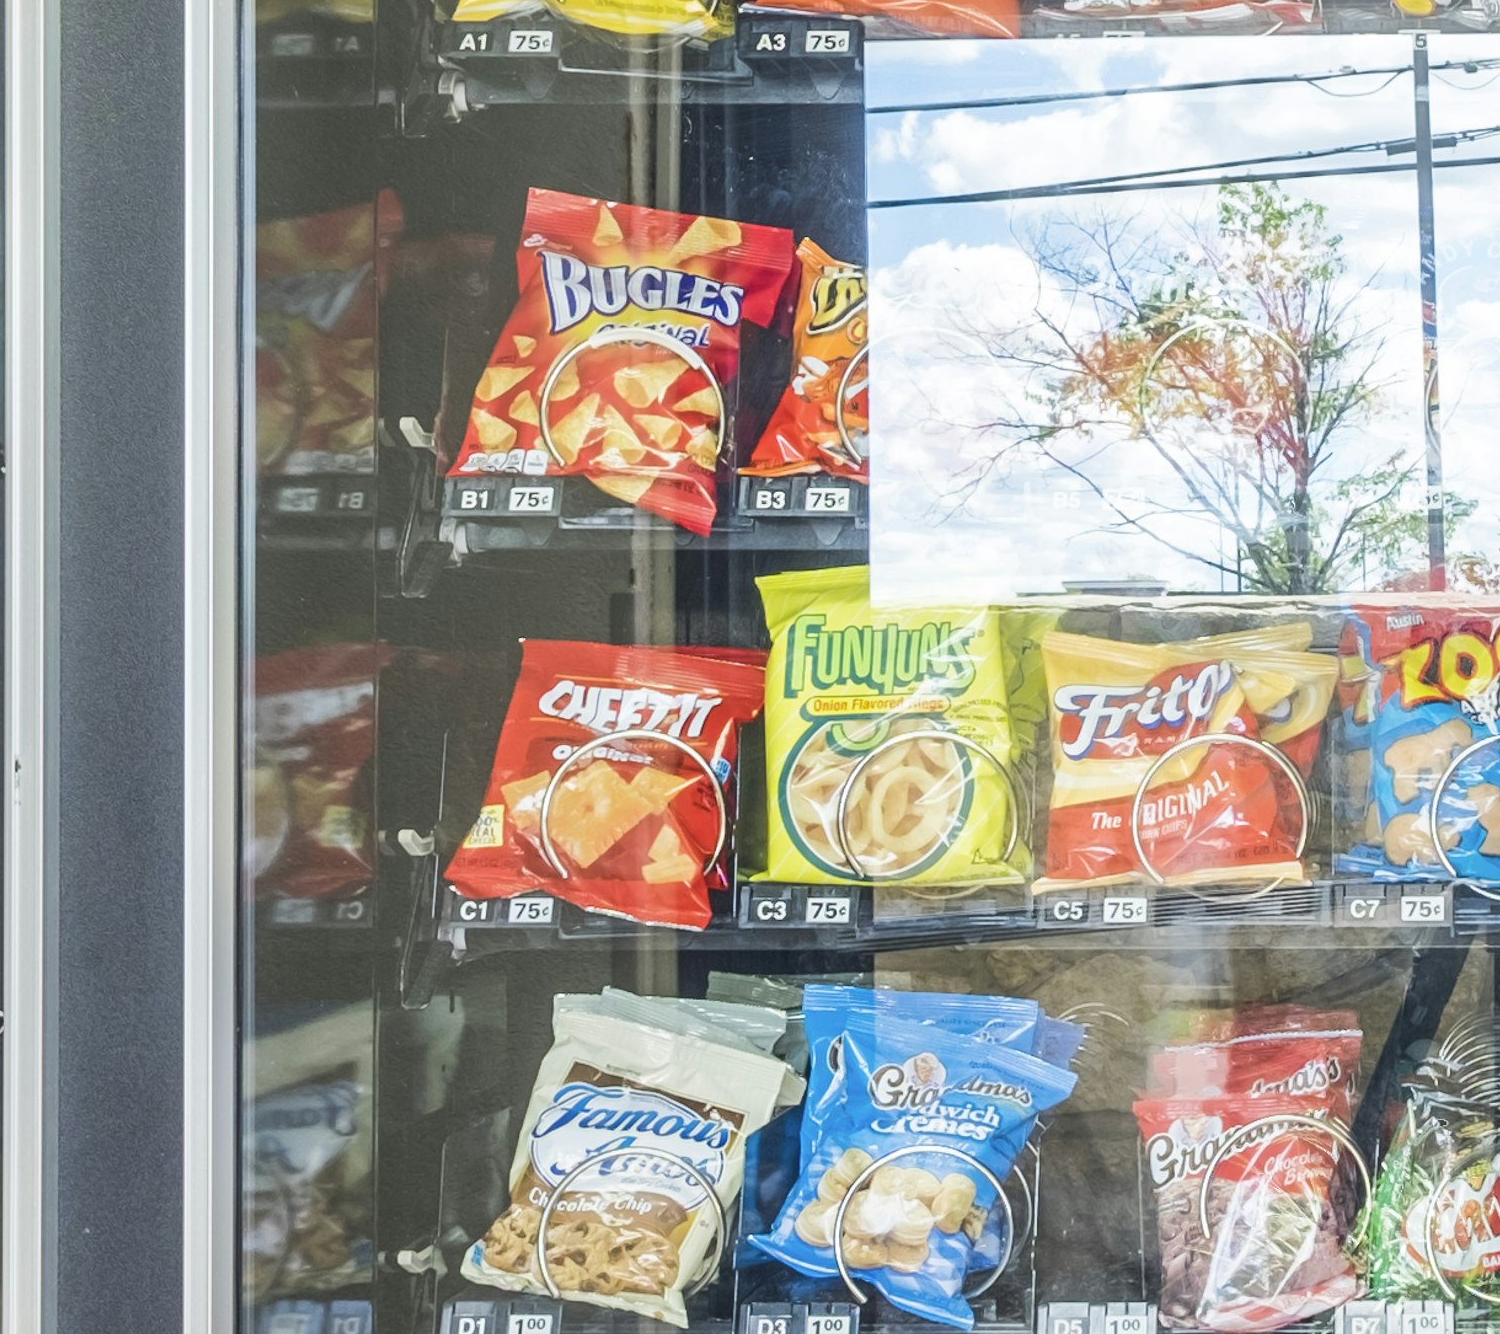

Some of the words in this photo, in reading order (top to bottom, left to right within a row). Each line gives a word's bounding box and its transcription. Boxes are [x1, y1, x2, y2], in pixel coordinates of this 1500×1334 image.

[459, 33, 488, 51] A1
[514, 34, 551, 51] 75¢
[756, 33, 786, 51] A3
[810, 33, 846, 51] 75¢
[541, 251, 745, 334] BUGLES
[460, 491, 488, 509] B1
[514, 492, 550, 508] 75¢
[756, 491, 786, 509] B3
[810, 492, 846, 508] 75¢
[812, 698, 848, 713] Onion
[907, 697, 944, 714] ings
[1054, 659, 1245, 761] Frito
[1092, 811, 1123, 830] The
[1130, 769, 1230, 827] RIGINAL
[459, 901, 488, 920] C1
[514, 902, 550, 919] 75¢
[756, 901, 787, 921] C3
[810, 902, 847, 920] 75¢
[1053, 901, 1083, 921] C5
[1107, 902, 1143, 919] 75¢
[1350, 899, 1381, 918] C7
[1404, 900, 1442, 918] 75¢
[869, 1063, 1033, 1111] Gradma's
[531, 1080, 731, 1149] Famous
[916, 1099, 1000, 1128] dwich
[528, 1187, 606, 1214] Chcolate
[613, 1195, 653, 1215] Chip
